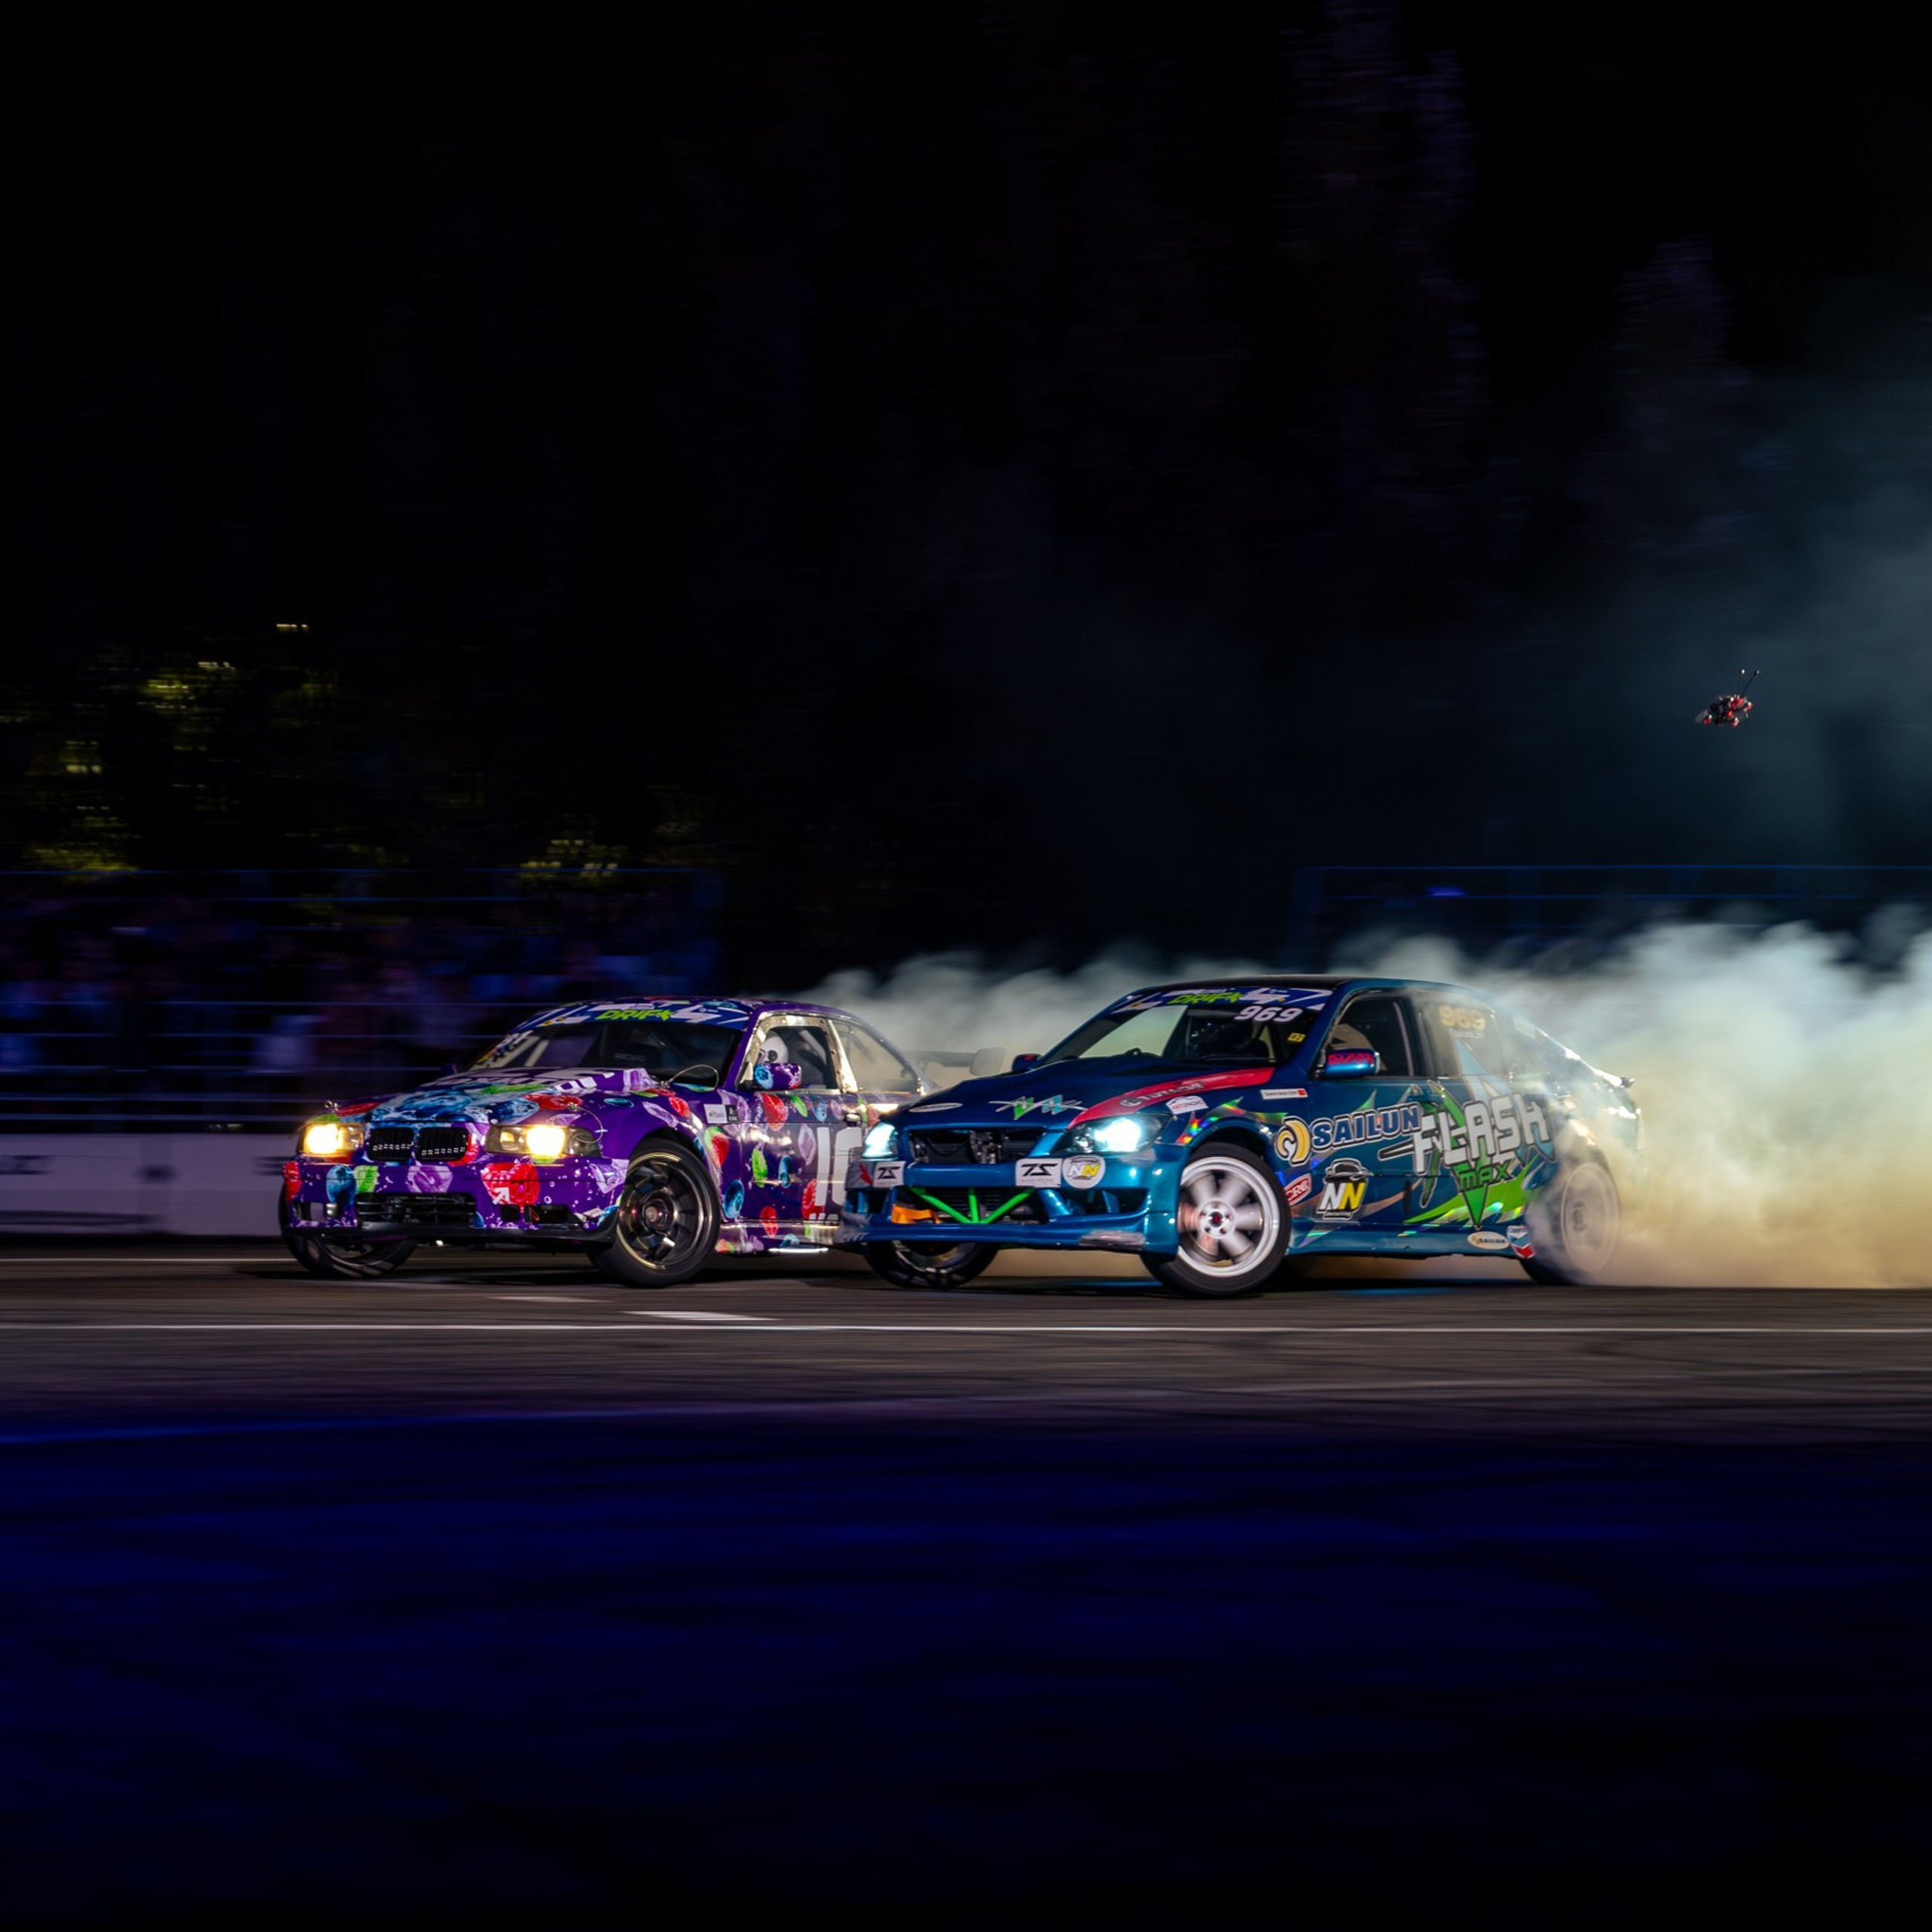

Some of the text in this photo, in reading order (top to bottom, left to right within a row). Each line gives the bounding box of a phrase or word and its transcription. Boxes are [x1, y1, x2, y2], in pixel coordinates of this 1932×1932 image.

[1234, 1005, 1303, 1023] 969
[1310, 1103, 1423, 1152] SAILUN
[1412, 1093, 1552, 1176] FLASH
[1066, 1163, 1101, 1177] NN
[1318, 1182, 1366, 1211] NN
